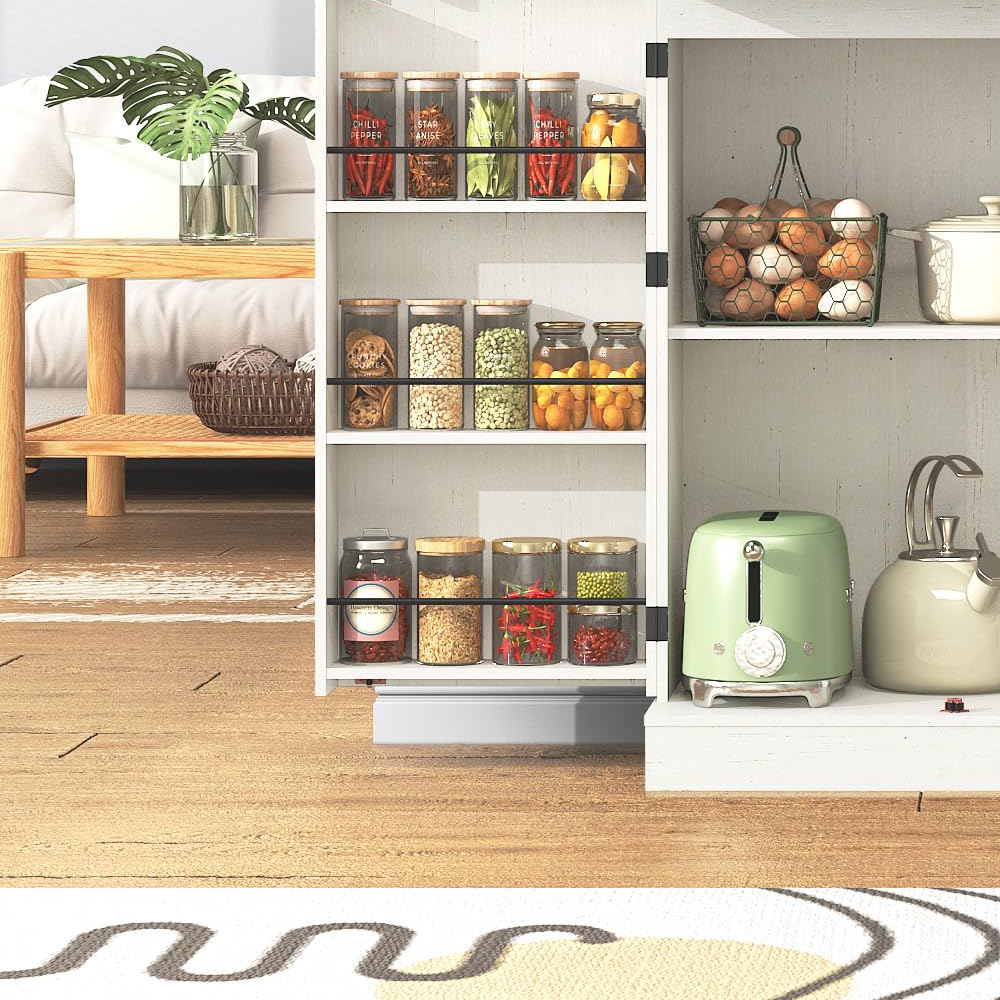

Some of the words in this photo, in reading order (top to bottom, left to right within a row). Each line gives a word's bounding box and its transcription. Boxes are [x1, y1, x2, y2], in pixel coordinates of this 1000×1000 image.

[353, 120, 379, 129] CHILLI
[417, 120, 438, 128] STAR
[535, 120, 562, 129] CHILLI
[351, 131, 382, 140] PEPPER
[416, 132, 441, 140] ANISE
[533, 131, 565, 140] PEPPER
